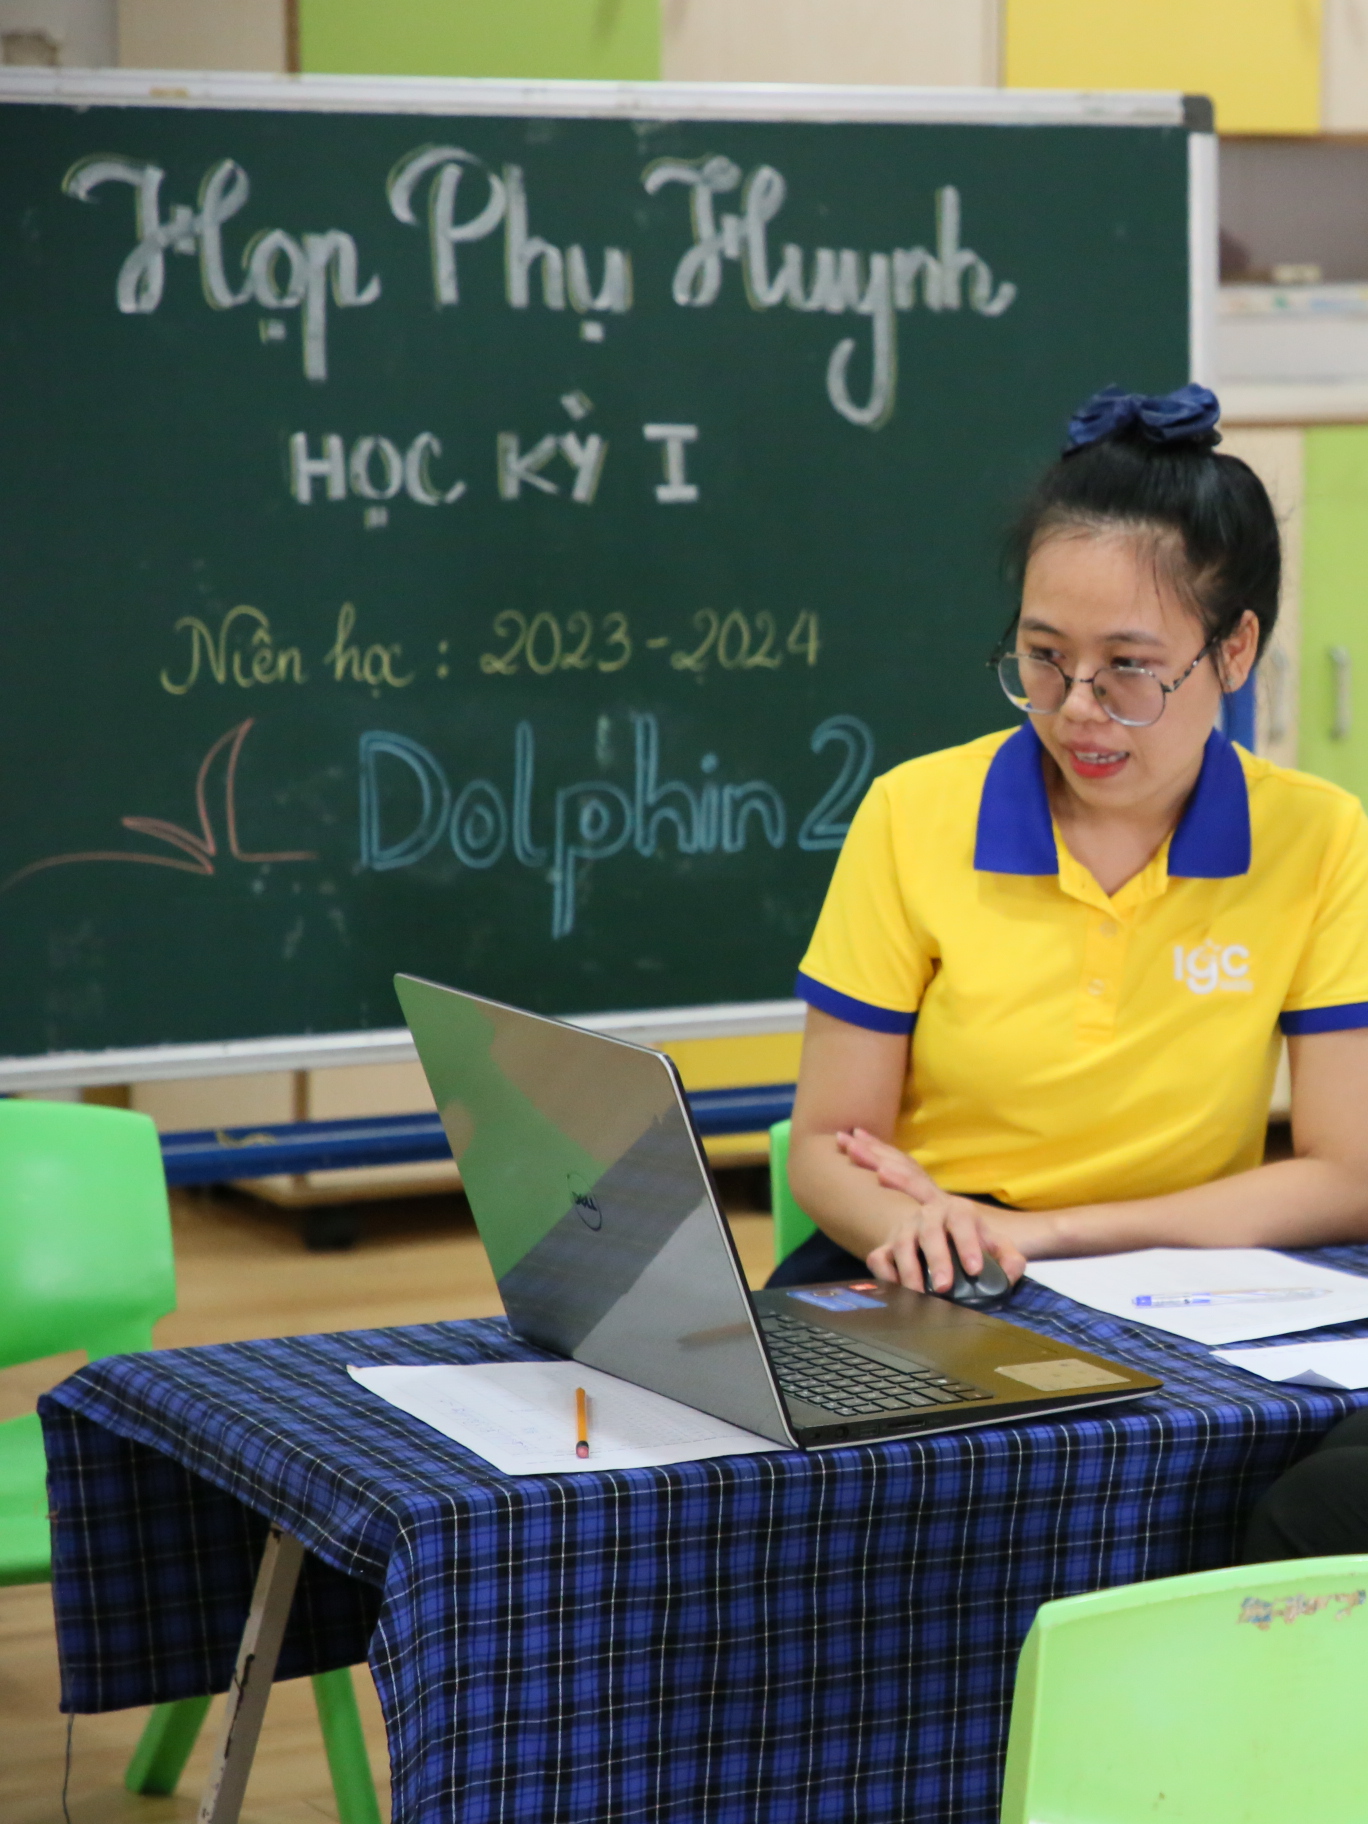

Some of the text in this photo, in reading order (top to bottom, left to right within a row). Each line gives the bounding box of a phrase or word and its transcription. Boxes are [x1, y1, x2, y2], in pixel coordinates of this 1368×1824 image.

[62, 144, 1018, 430] Họp Phụ Huynh
[289, 431, 467, 530] HỌC
[643, 423, 698, 504] I
[160, 604, 309, 695] Niên
[359, 712, 875, 939] Dolphin 2
